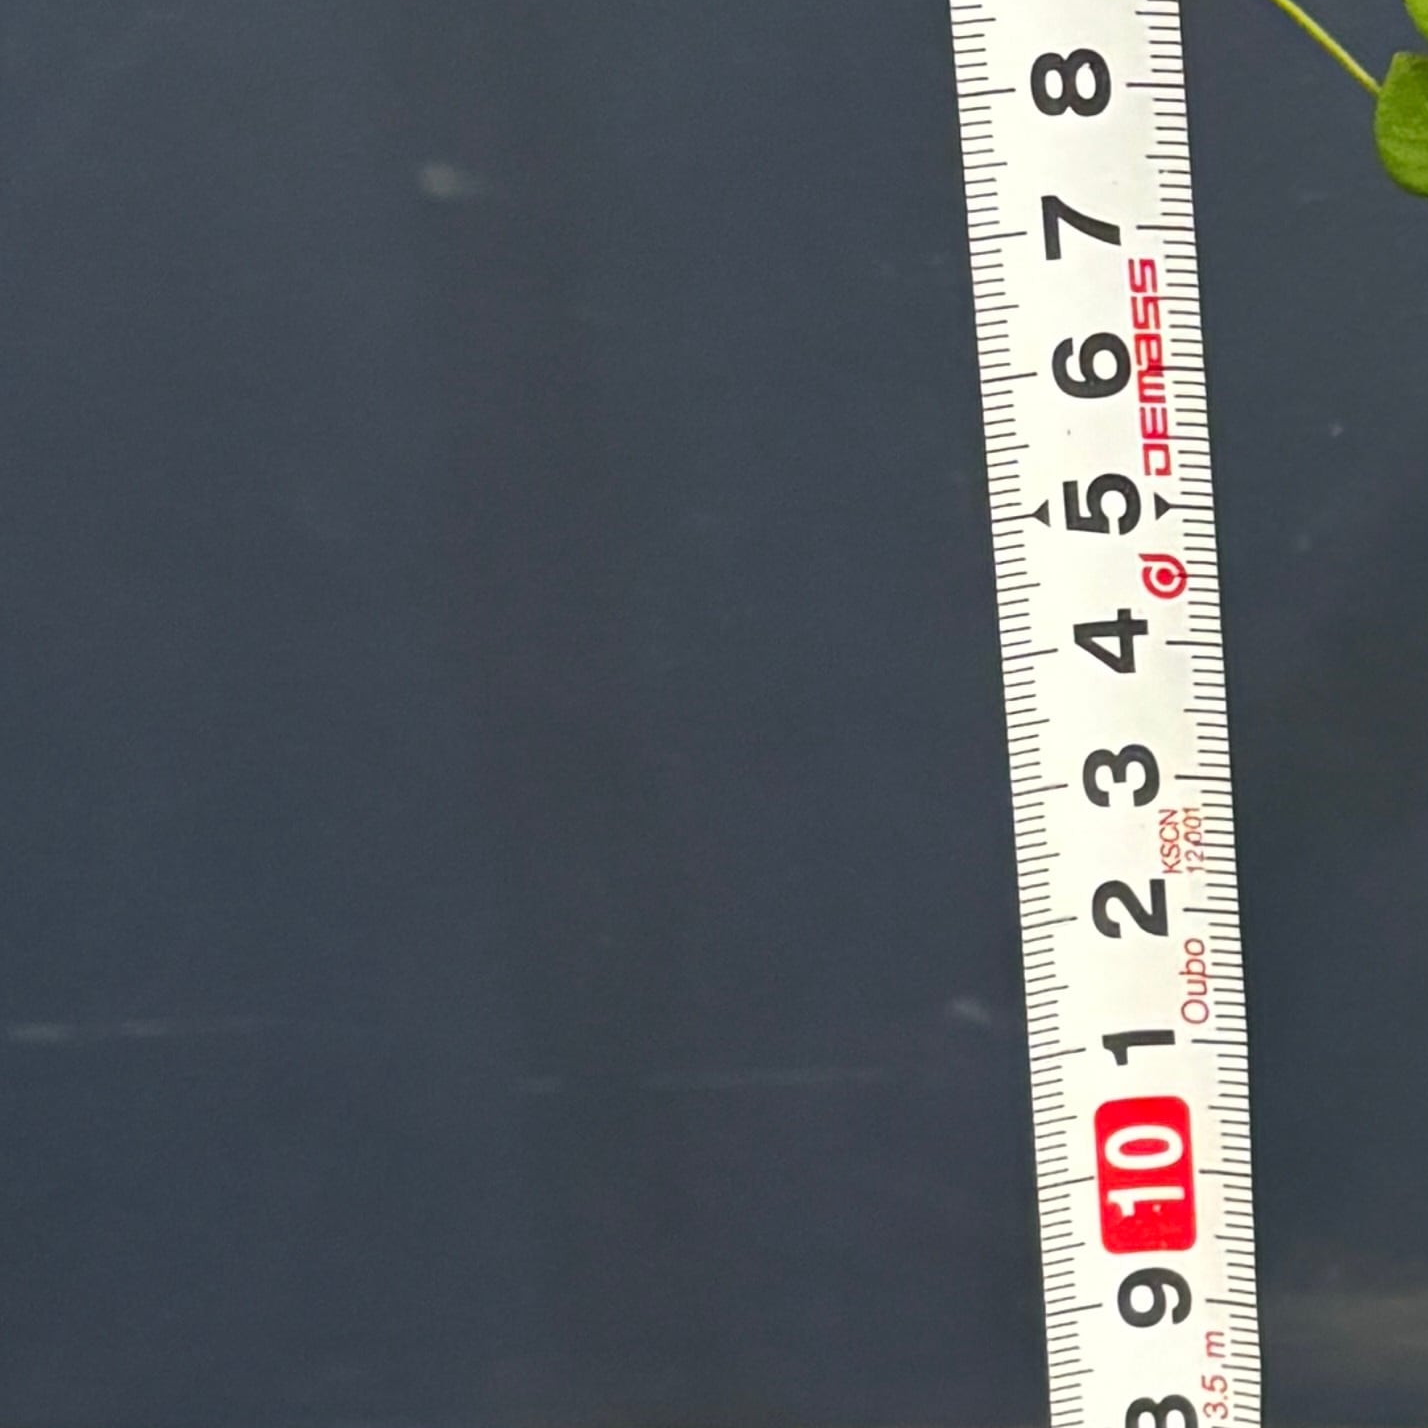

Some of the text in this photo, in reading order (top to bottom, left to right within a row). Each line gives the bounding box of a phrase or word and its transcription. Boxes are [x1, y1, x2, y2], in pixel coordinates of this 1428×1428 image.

[1030, 48, 1111, 117] 8
[1041, 194, 1121, 261] 7
[1052, 332, 1132, 399] 6
[1062, 473, 1141, 535] 5
[1072, 608, 1149, 675] 4
[1082, 744, 1160, 807] 3
[1158, 808, 1182, 874] KSCN
[1092, 878, 1169, 938] 2
[1179, 938, 1210, 1024] Oubo
[1102, 1030, 1175, 1066] 1
[1104, 1123, 1186, 1218] 10
[1117, 1267, 1192, 1328] 9
[1201, 1374, 1229, 1420] 3.5
